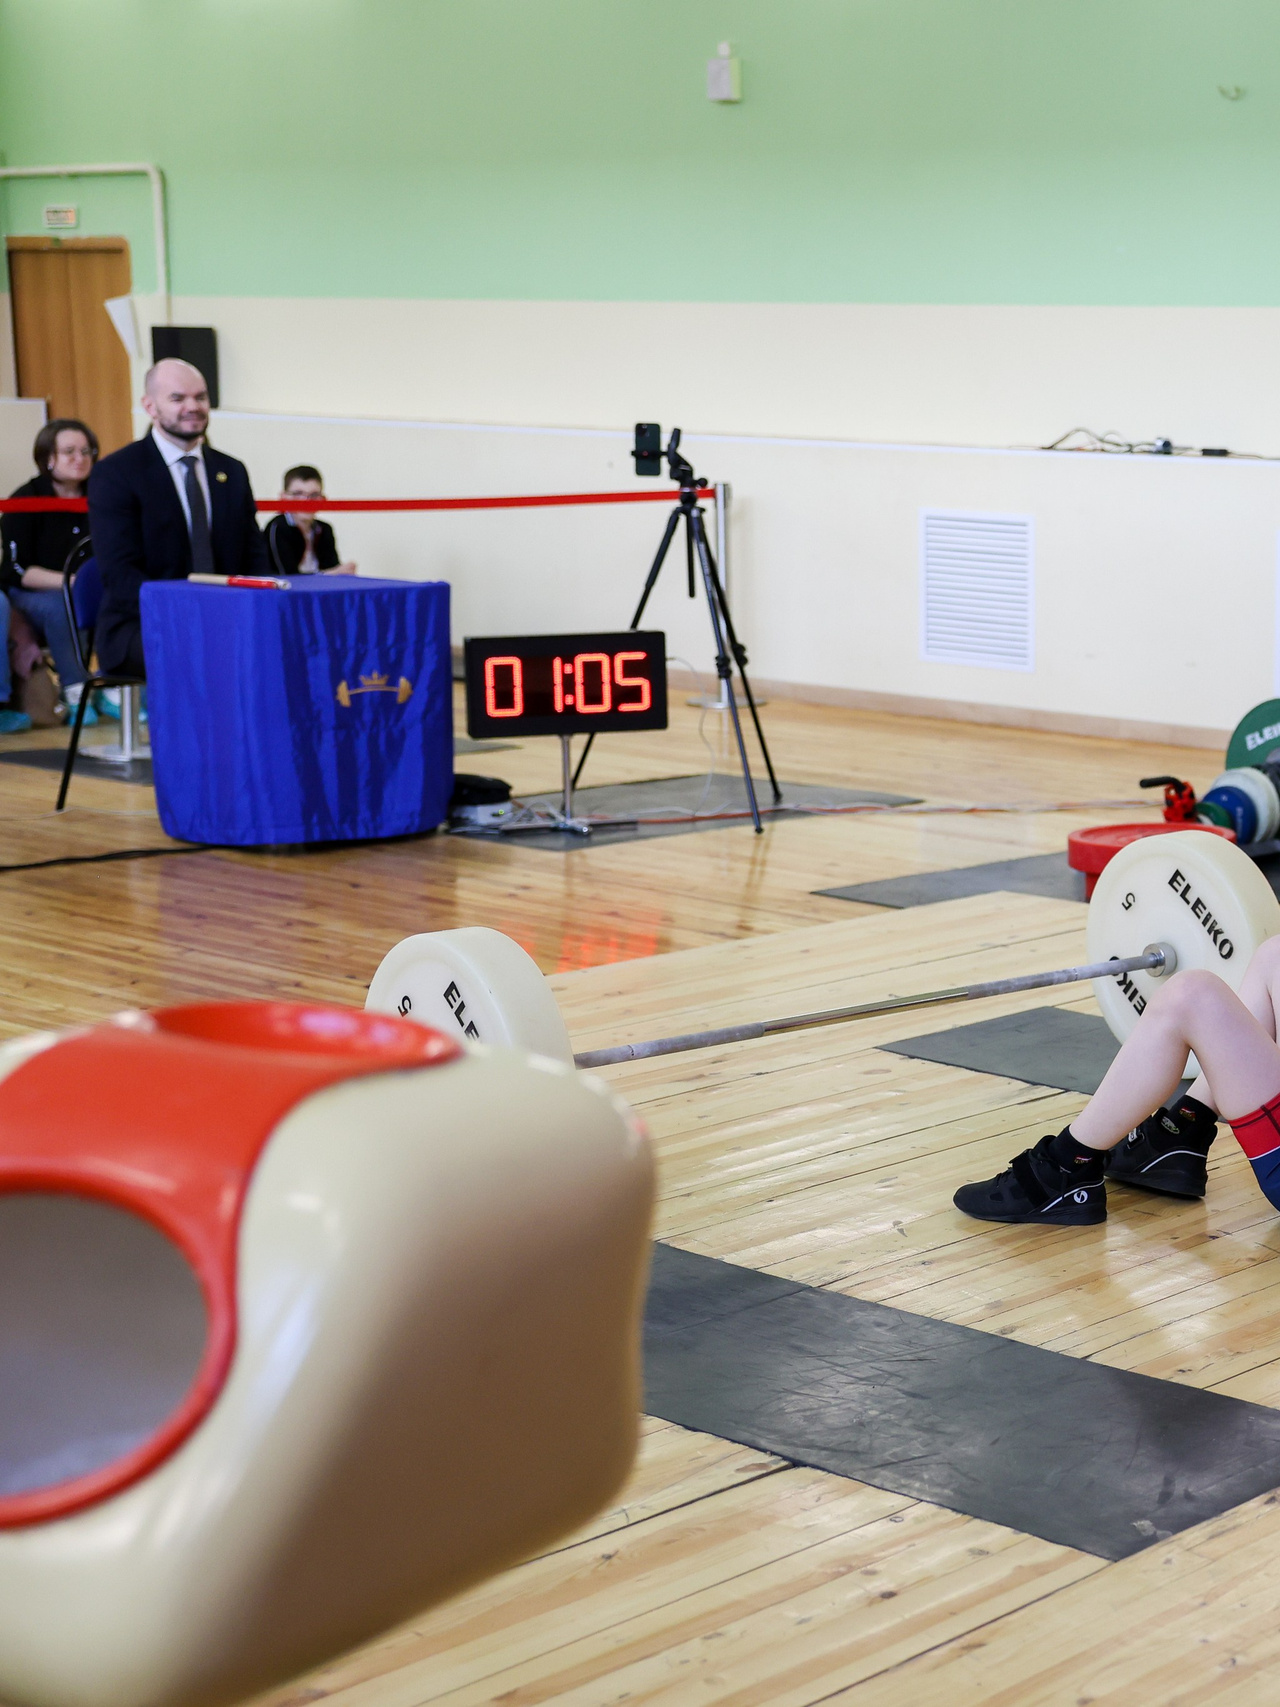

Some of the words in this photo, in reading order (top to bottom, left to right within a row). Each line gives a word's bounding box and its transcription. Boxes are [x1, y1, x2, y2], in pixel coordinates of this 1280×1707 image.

[1121, 892, 1136, 911] 5
[1167, 868, 1234, 960] ELEIKO
[397, 995, 412, 1018] 5
[443, 980, 480, 1041] ELE
[1109, 956, 1148, 1017] EIK
